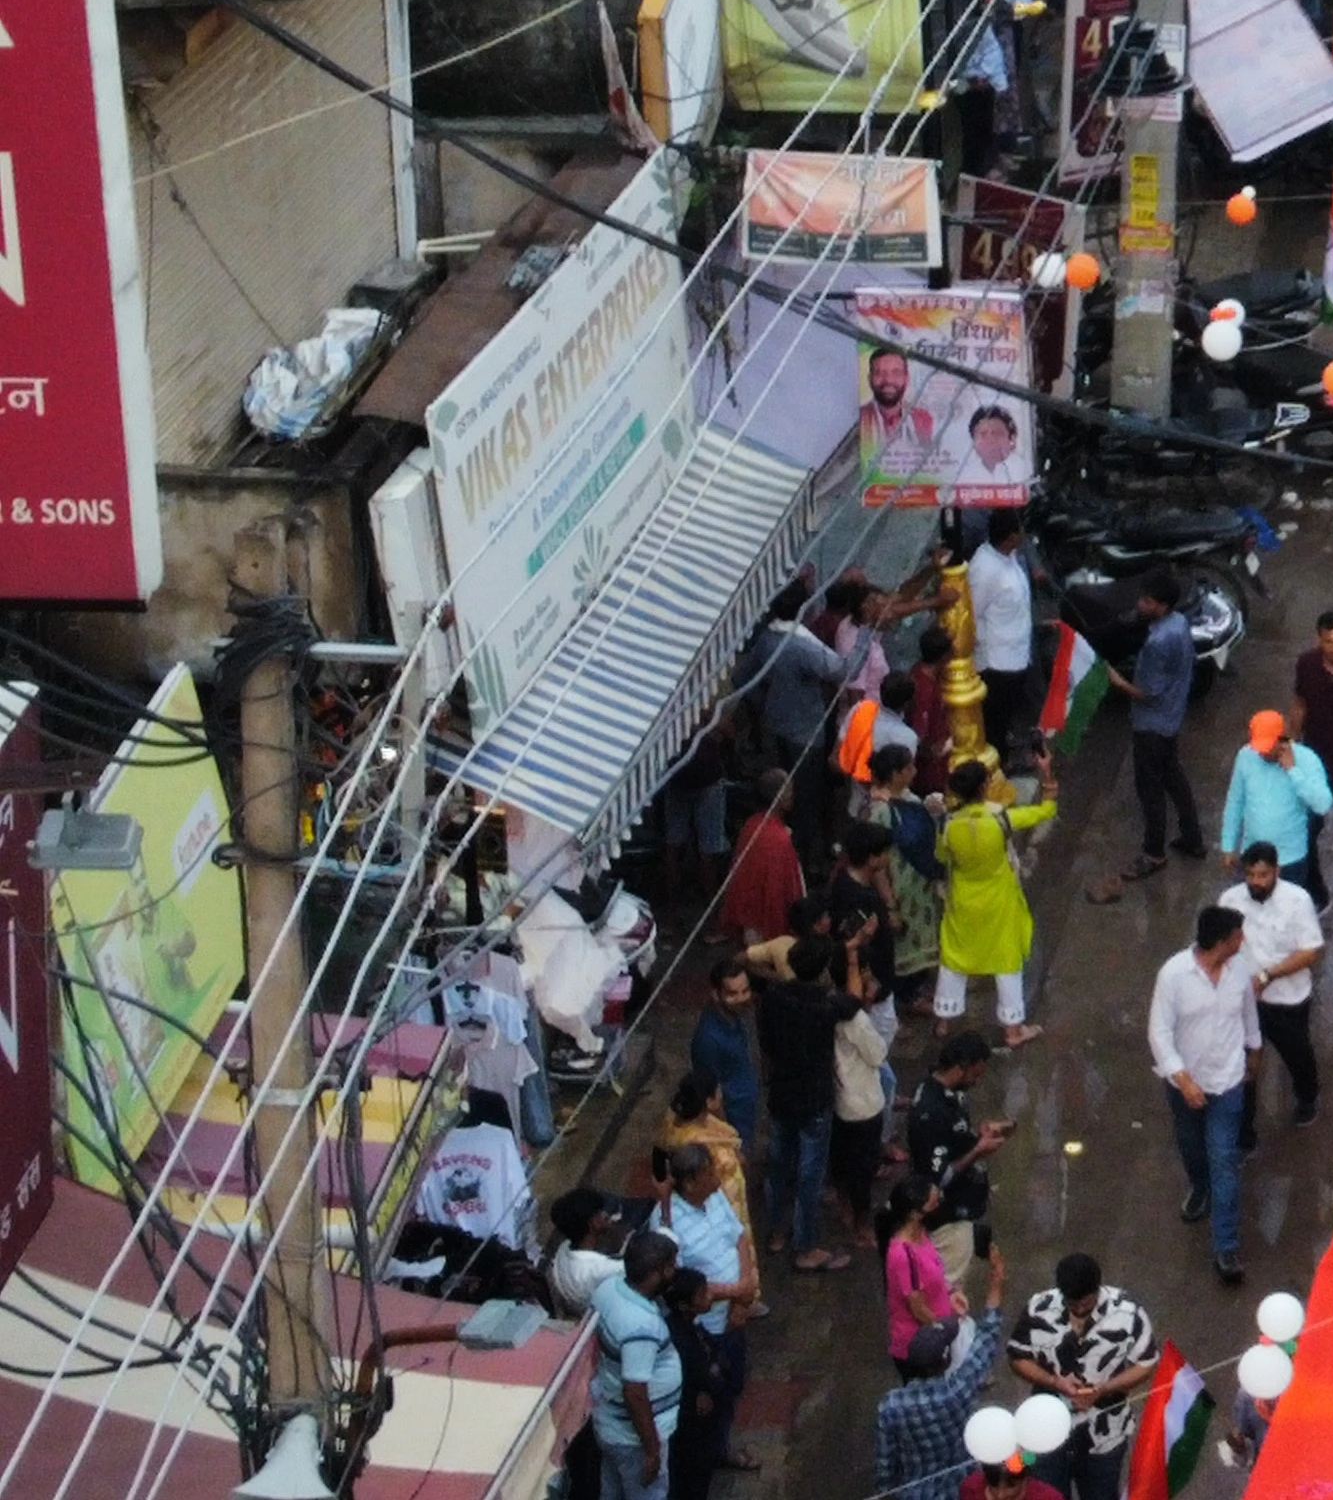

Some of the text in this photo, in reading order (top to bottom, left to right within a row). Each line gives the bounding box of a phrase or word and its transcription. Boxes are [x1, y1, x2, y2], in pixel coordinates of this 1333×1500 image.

[455, 392, 534, 526] VIKAS
[532, 235, 671, 442] ENTERPRISES
[11, 497, 116, 526] & SONS
